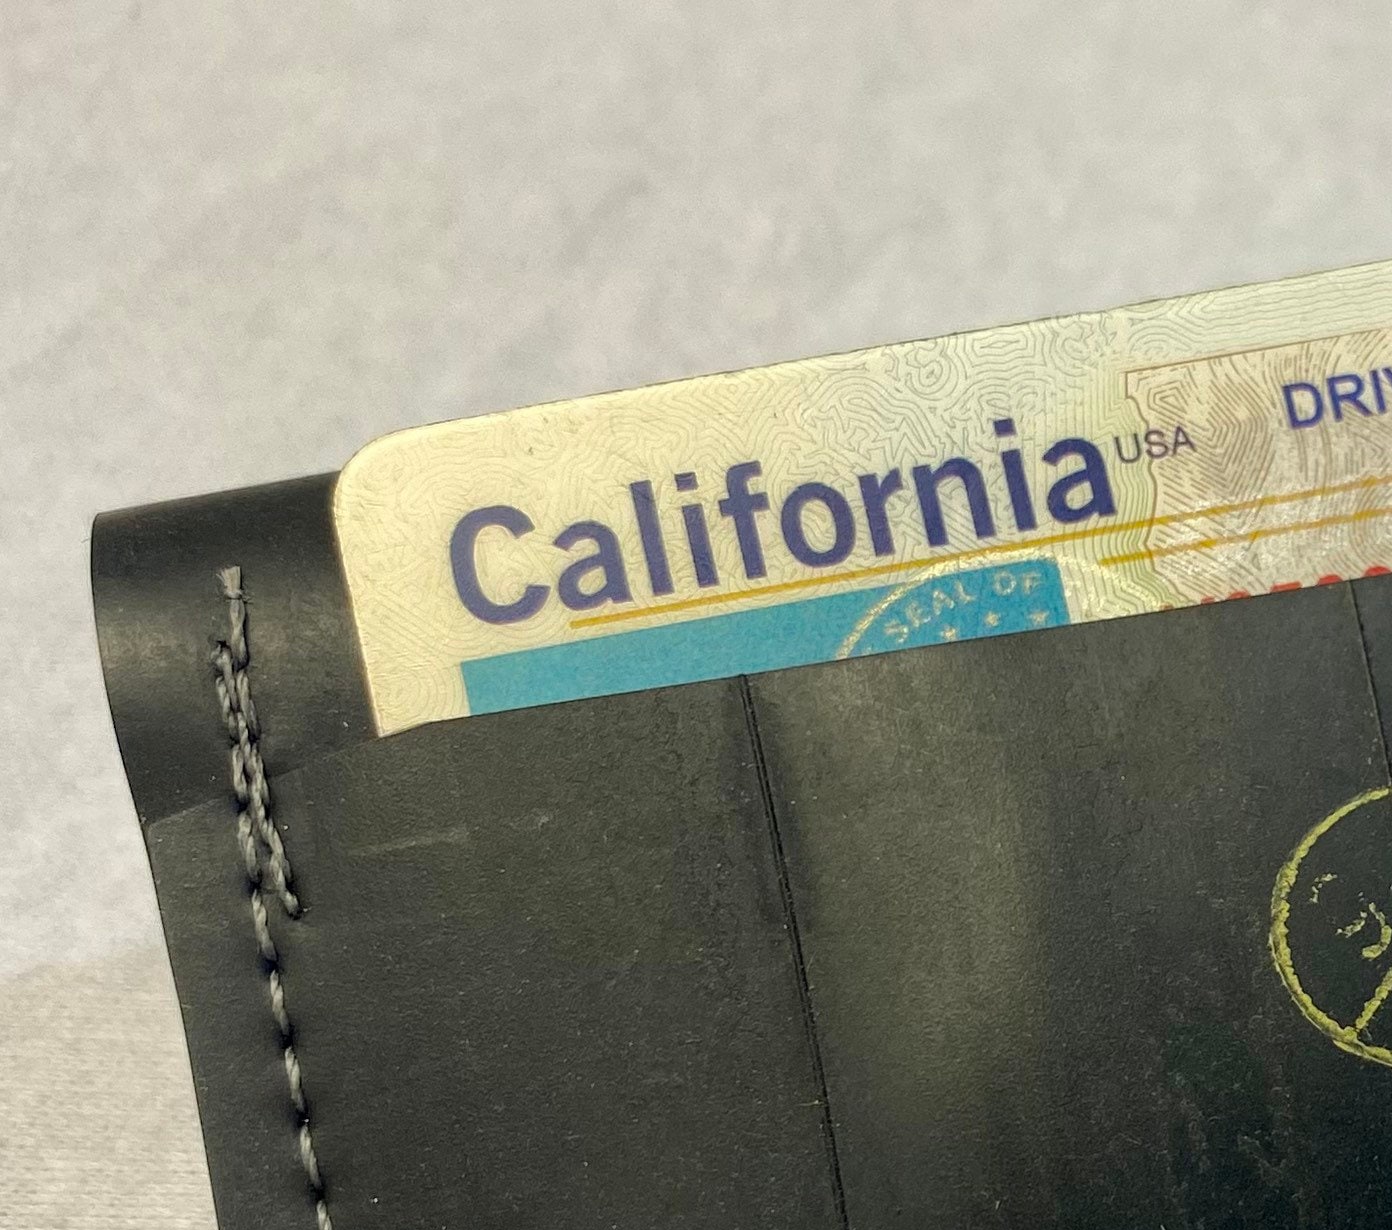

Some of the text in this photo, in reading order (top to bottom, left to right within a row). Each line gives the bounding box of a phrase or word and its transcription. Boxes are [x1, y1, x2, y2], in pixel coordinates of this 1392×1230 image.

[450, 419, 1116, 625] California
[1114, 426, 1196, 465] USA
[884, 571, 1042, 644] SEAL OF
